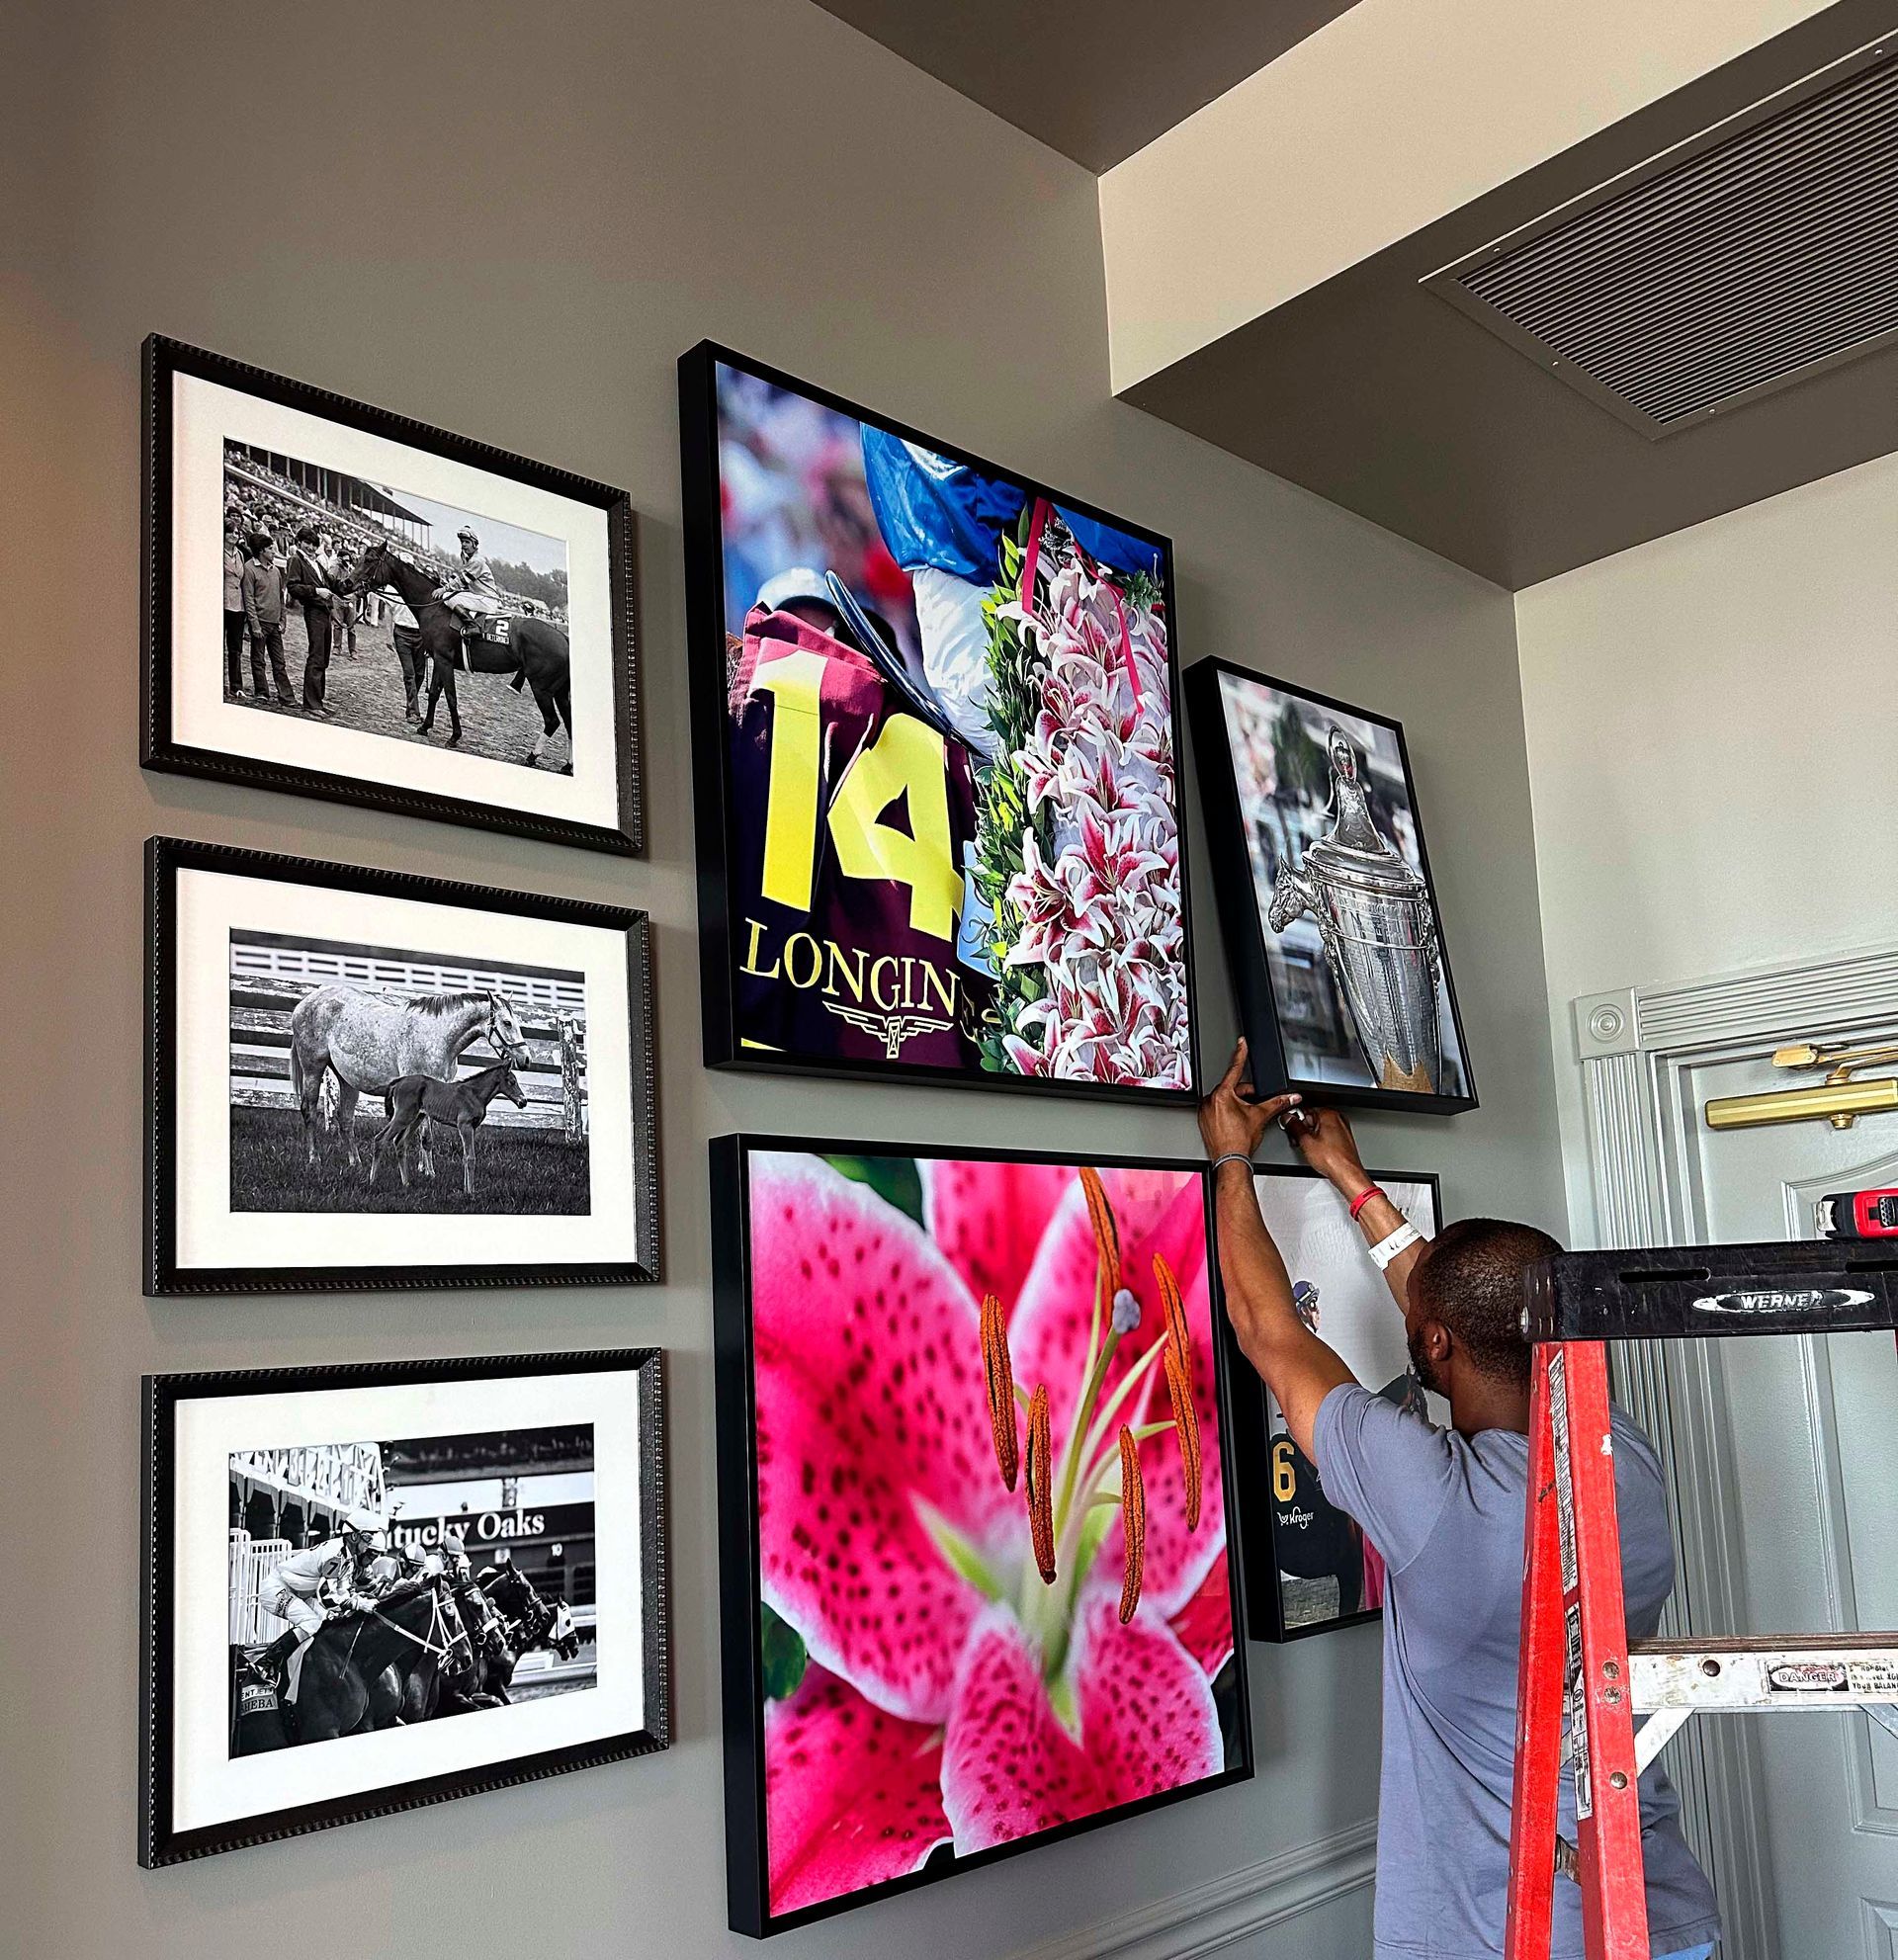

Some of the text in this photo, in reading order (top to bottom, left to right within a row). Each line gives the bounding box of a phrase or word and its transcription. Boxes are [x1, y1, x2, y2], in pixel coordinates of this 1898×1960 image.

[496, 619, 509, 637] 2
[746, 649, 965, 942] 14
[739, 917, 1001, 1044] LONGIN
[1741, 1291, 1823, 1309] WERNER
[1273, 1441, 1296, 1502] 6
[477, 1509, 545, 1540] Oaks
[1289, 1506, 1314, 1529] Kroger
[326, 1562, 338, 1575] 7
[1779, 1671, 1837, 1683] DANGER
